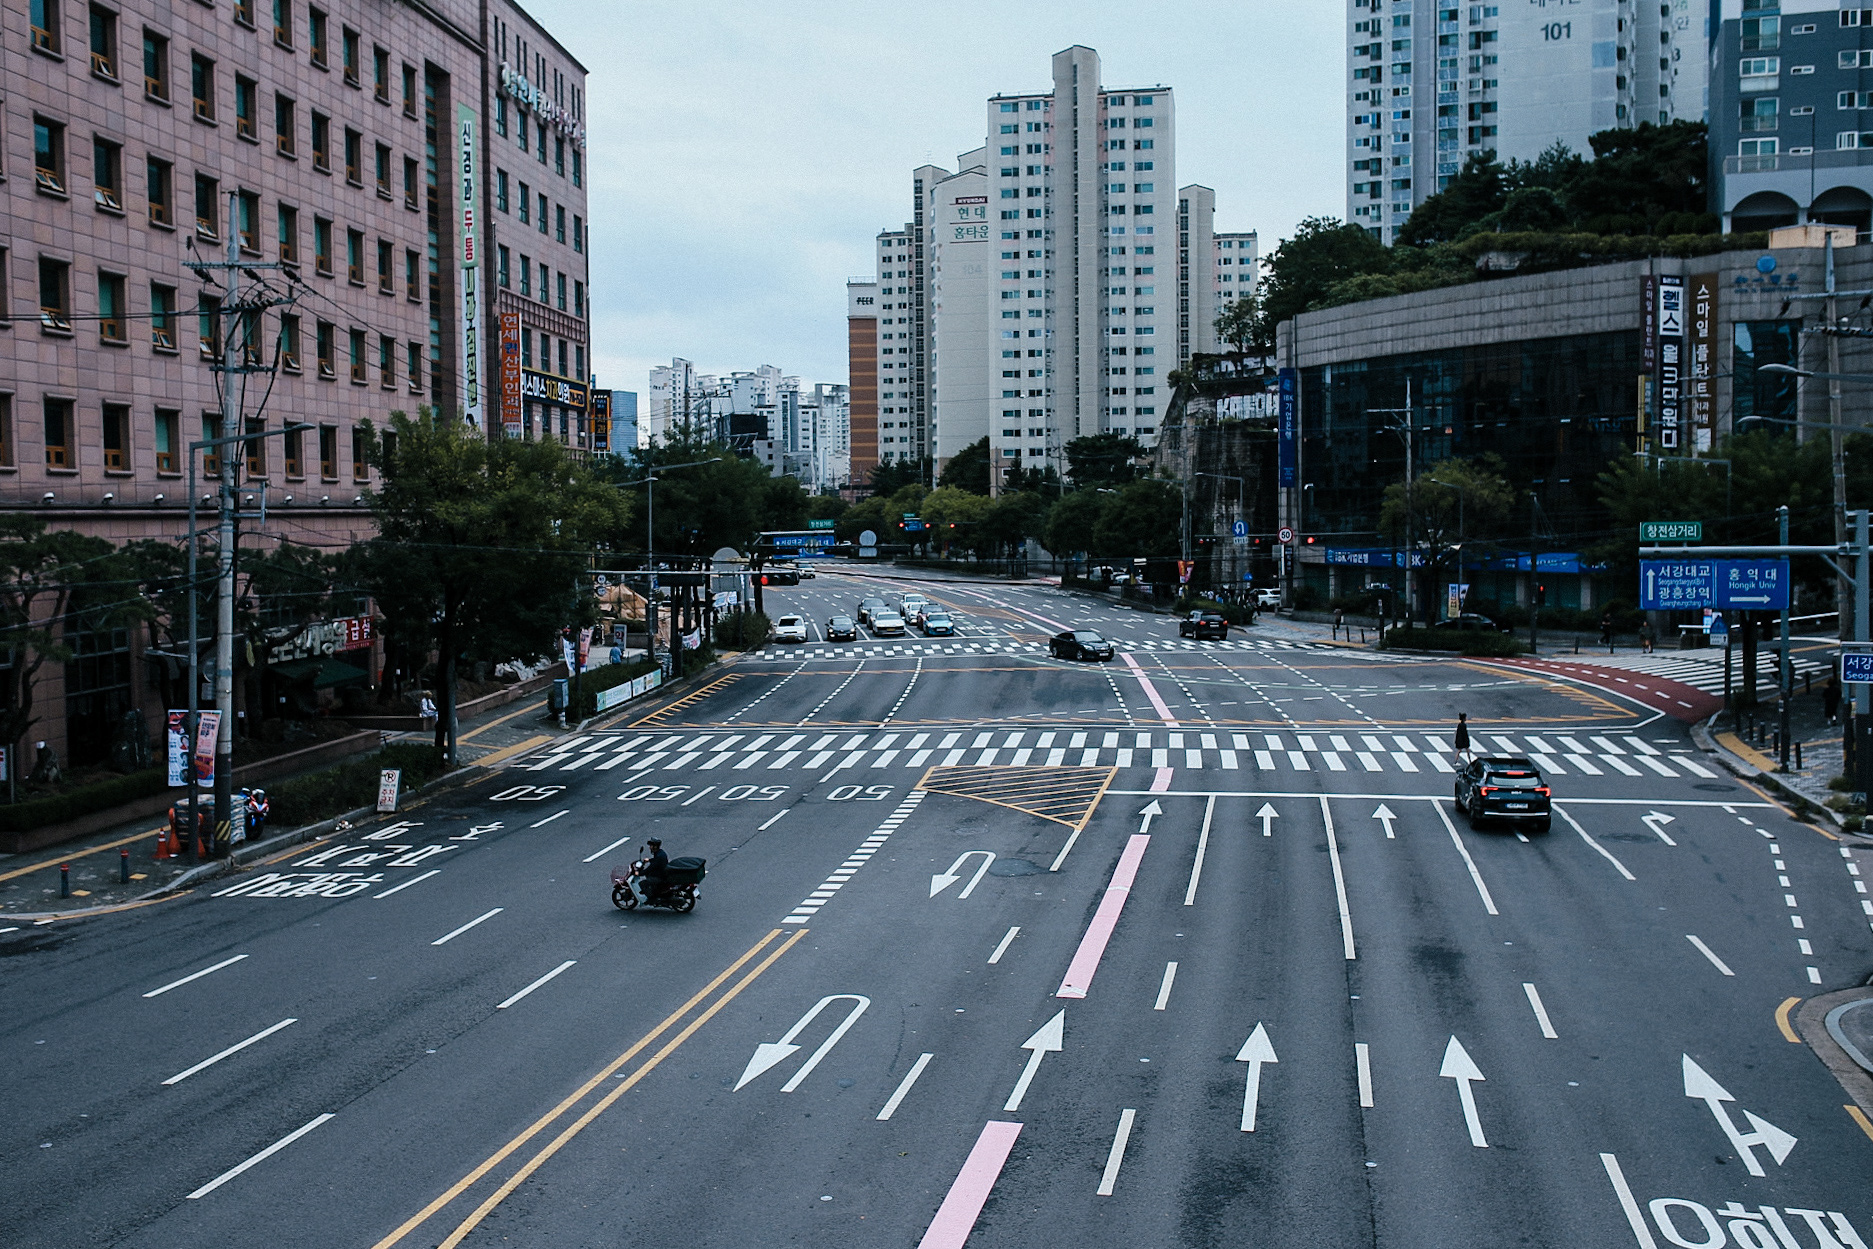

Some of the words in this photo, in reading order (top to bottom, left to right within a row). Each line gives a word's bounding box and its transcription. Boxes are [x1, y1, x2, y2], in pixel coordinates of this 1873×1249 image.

[1541, 21, 1571, 41] 101
[955, 225, 988, 240] 홈타운
[1662, 290, 1680, 332] 헬스
[1696, 284, 1710, 338] 스마일
[1281, 531, 1291, 539] 50
[1647, 524, 1697, 538] 창전삼거리
[1658, 565, 1711, 577] 서강대교
[1658, 586, 1710, 600] 광흥창역
[1729, 581, 1756, 591] Hongik
[1759, 581, 1776, 589] Univ
